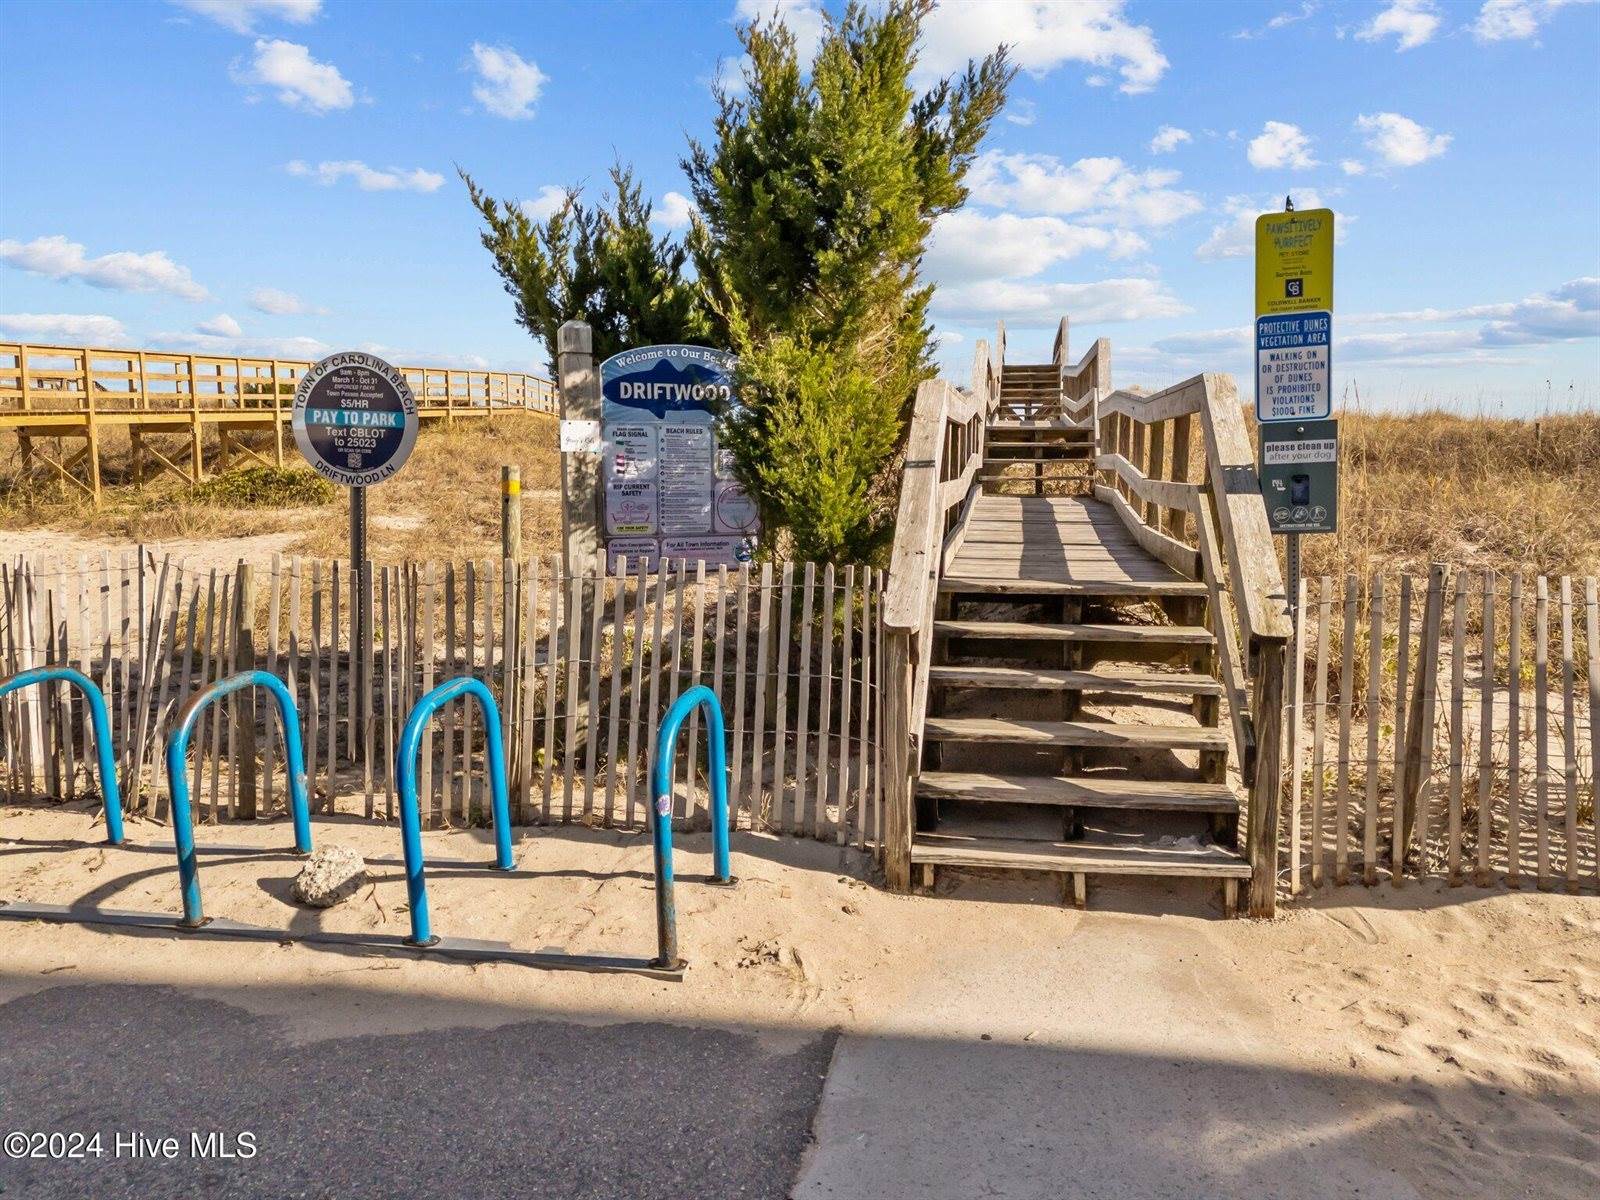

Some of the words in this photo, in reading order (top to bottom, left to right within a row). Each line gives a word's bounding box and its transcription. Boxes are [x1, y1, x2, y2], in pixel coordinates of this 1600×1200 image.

[1259, 321, 1300, 334] PROTECTIVE
[1304, 318, 1328, 332] DUNES
[1261, 334, 1304, 347] VEGETATION
[1307, 332, 1327, 343] AREA
[616, 349, 663, 368] Welcome
[666, 348, 677, 357] to
[680, 347, 701, 358] Our
[703, 351, 736, 370] Beh
[1270, 351, 1303, 362] WALKING
[1306, 350, 1317, 360] ON
[1262, 364, 1272, 374] OR
[1275, 361, 1326, 373] DESTRUCTION
[1274, 374, 1284, 383] OF
[1288, 373, 1313, 383] DUNES
[296, 376, 315, 410] TOWN
[314, 363, 330, 377] OF
[331, 354, 390, 377] CAROLINA
[390, 374, 415, 415] BEACH
[1266, 386, 1274, 395] IS
[1277, 383, 1321, 394] PROHIBITED
[620, 381, 731, 401] DRIFTWOOD
[341, 398, 369, 409] $5/HR
[1272, 394, 1315, 405] VIOLATIONS
[1272, 406, 1295, 417] $1000
[1299, 405, 1316, 414] FINE
[313, 410, 338, 424] PAY
[342, 411, 359, 425] TO
[362, 412, 397, 426] PARK
[325, 426, 348, 437] Text
[349, 427, 386, 439] CBLOT
[334, 438, 345, 447] to
[347, 438, 377, 448] 25023
[1266, 443, 1295, 453] please
[1297, 442, 1322, 451] clean
[1323, 442, 1335, 450] up
[1269, 453, 1289, 461] after
[1292, 452, 1312, 461] your
[1313, 451, 1331, 460] dog
[315, 460, 380, 485] DRIFTWOOD
[381, 463, 396, 478] LN
